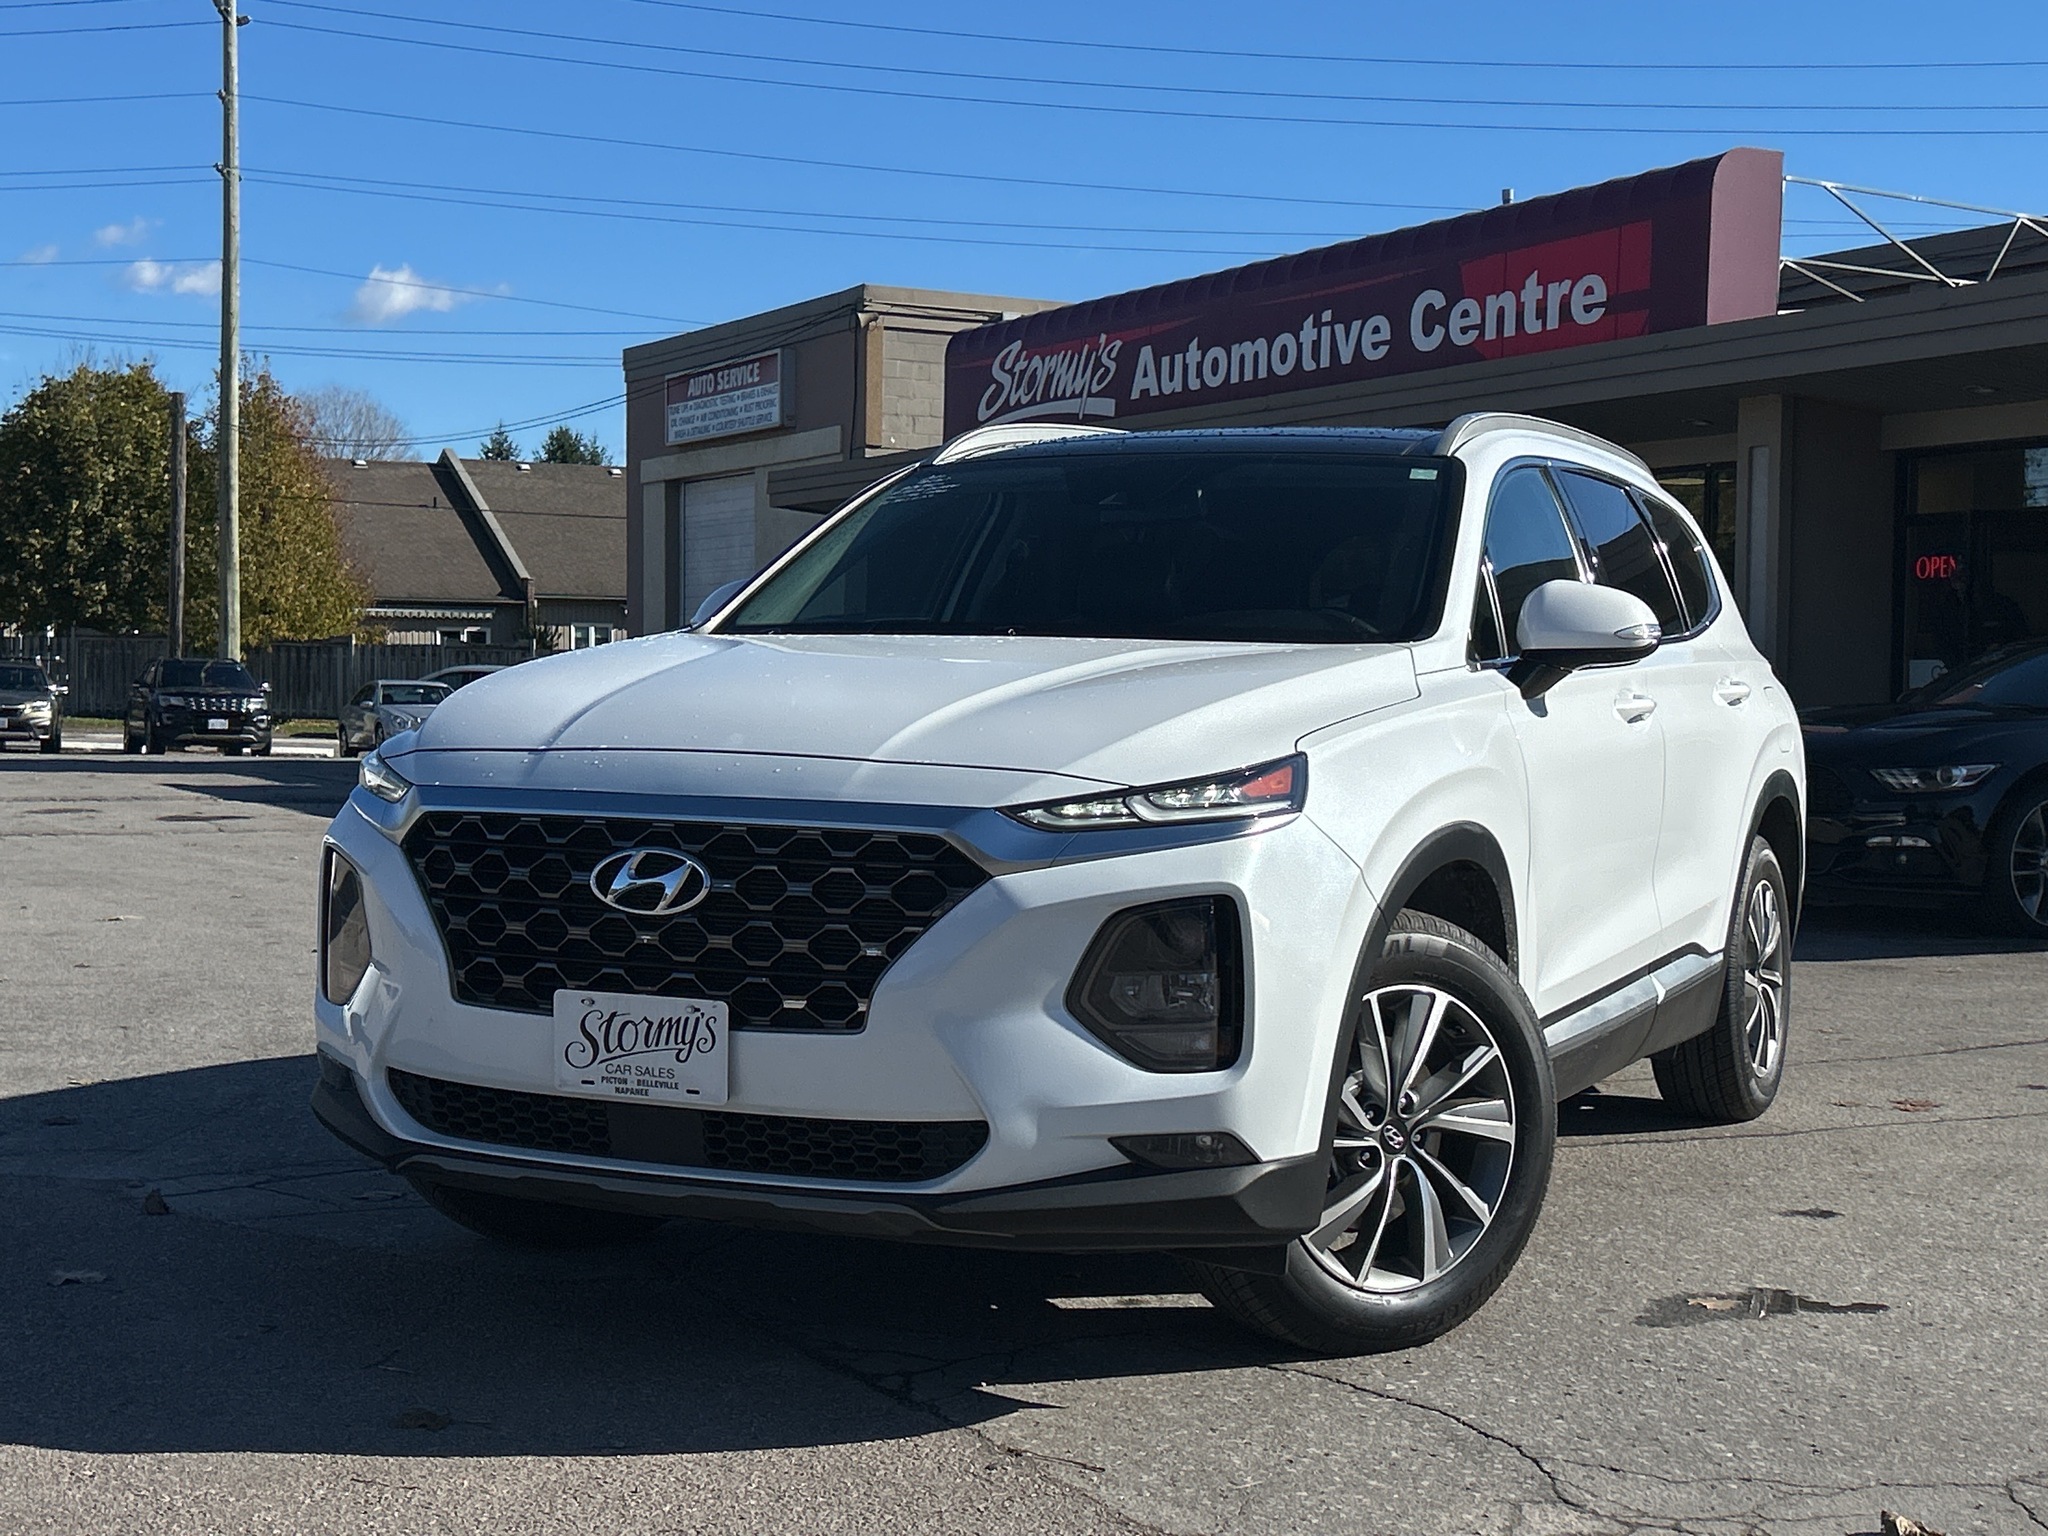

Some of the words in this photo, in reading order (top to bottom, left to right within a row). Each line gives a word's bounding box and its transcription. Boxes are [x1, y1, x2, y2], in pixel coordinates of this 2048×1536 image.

[977, 332, 1123, 421] Stormy's
[1130, 309, 1390, 400] Automotive
[1408, 269, 1608, 352] Centre
[687, 372, 715, 397] AUTO
[717, 362, 760, 391] SERVICE
[564, 1009, 718, 1069] Stormy's
[601, 1076, 628, 1086] PICTON
[636, 1079, 680, 1090] BELLEVILLE
[605, 1063, 632, 1076] CAR
[634, 1065, 676, 1080] SALES
[614, 1086, 650, 1097] NAPANEE
